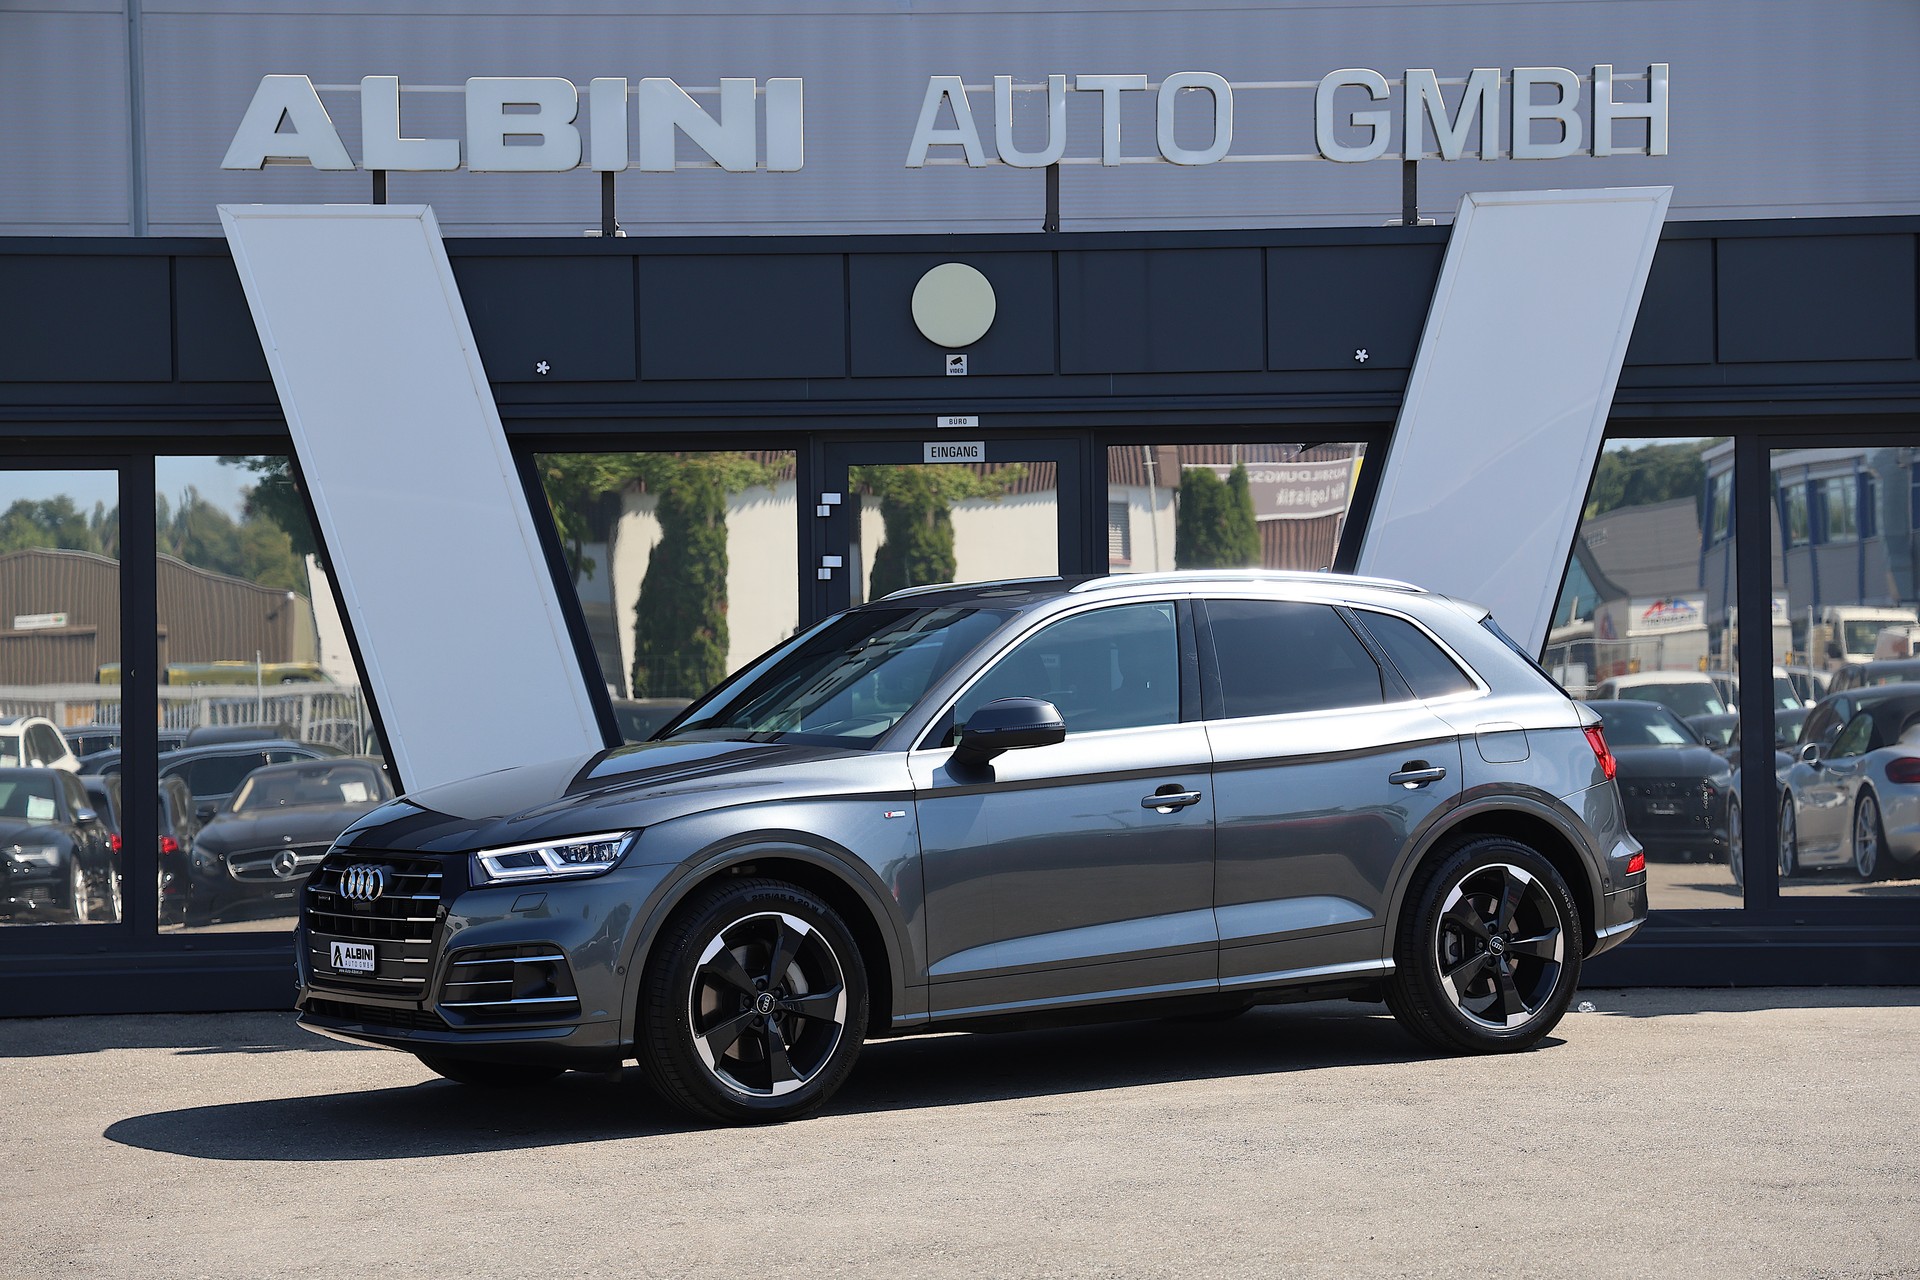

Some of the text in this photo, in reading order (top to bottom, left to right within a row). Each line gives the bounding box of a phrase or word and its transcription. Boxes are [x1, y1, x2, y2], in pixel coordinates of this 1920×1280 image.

[220, 62, 1669, 172] ALBINI AUTO GMBH
[949, 417, 967, 425] BÜRO
[931, 446, 978, 458] EINGANG
[345, 947, 373, 961] ALBINI
